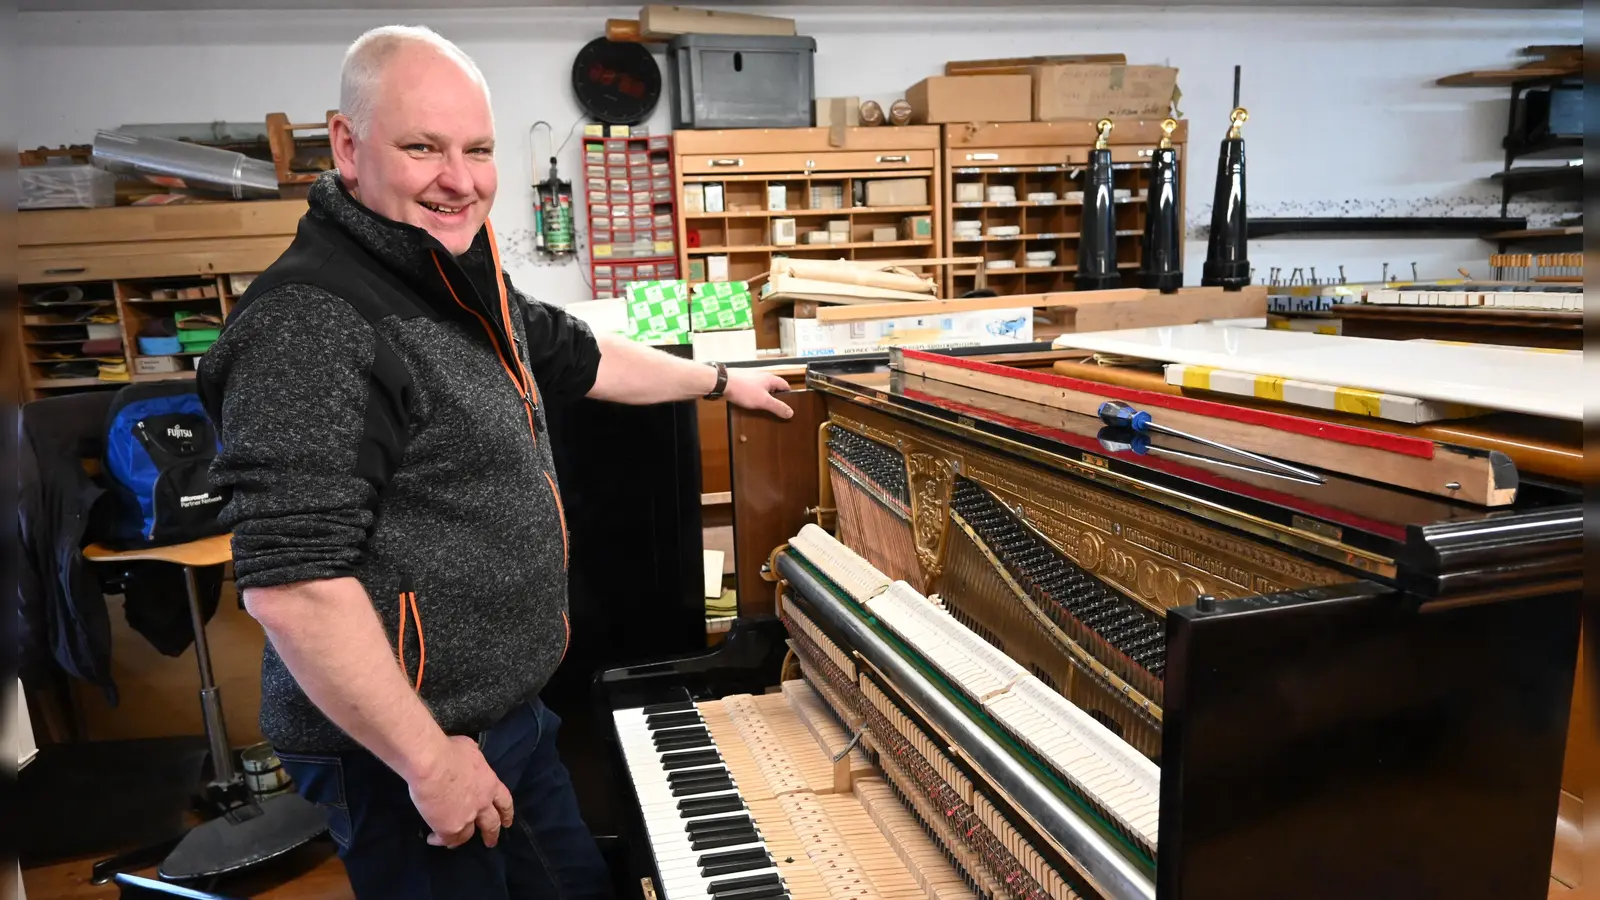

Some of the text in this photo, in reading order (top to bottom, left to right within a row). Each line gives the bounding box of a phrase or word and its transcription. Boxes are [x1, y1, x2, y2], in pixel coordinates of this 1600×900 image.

[166, 424, 192, 438] FUJITSU
[180, 492, 208, 502] Microsoft
[201, 494, 222, 504] Network
